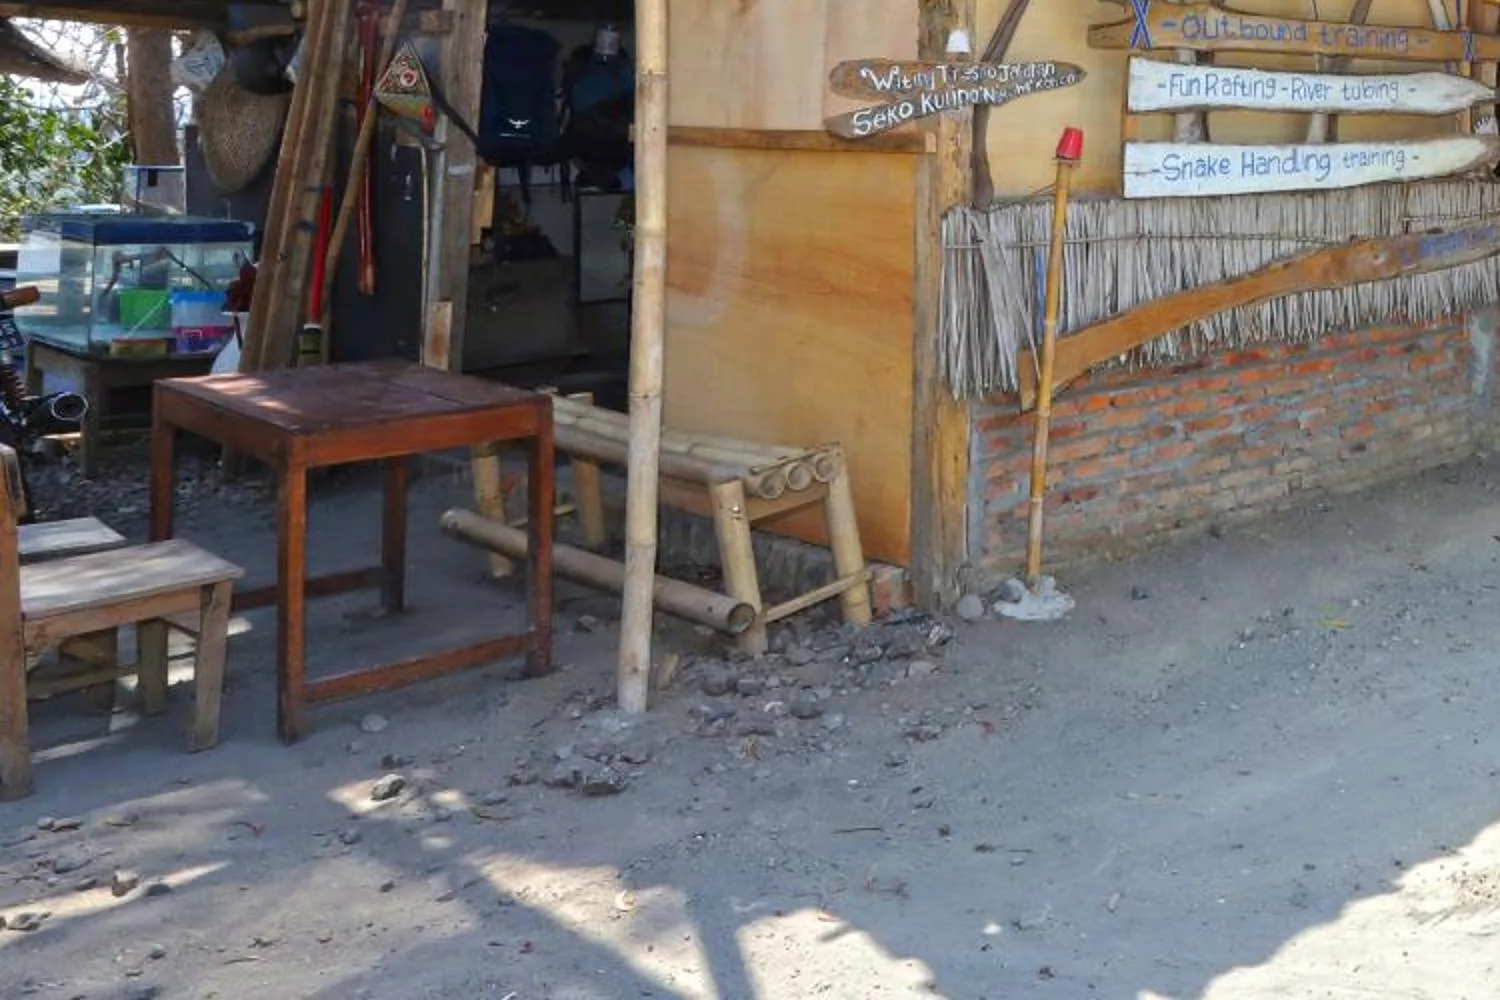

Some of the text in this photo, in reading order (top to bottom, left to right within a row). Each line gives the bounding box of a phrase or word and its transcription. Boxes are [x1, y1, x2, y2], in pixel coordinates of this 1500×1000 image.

[1320, 25, 1408, 52] training
[1205, 73, 1276, 99] Rafting
[1341, 79, 1399, 102] tubing
[1343, 149, 1405, 171] training
